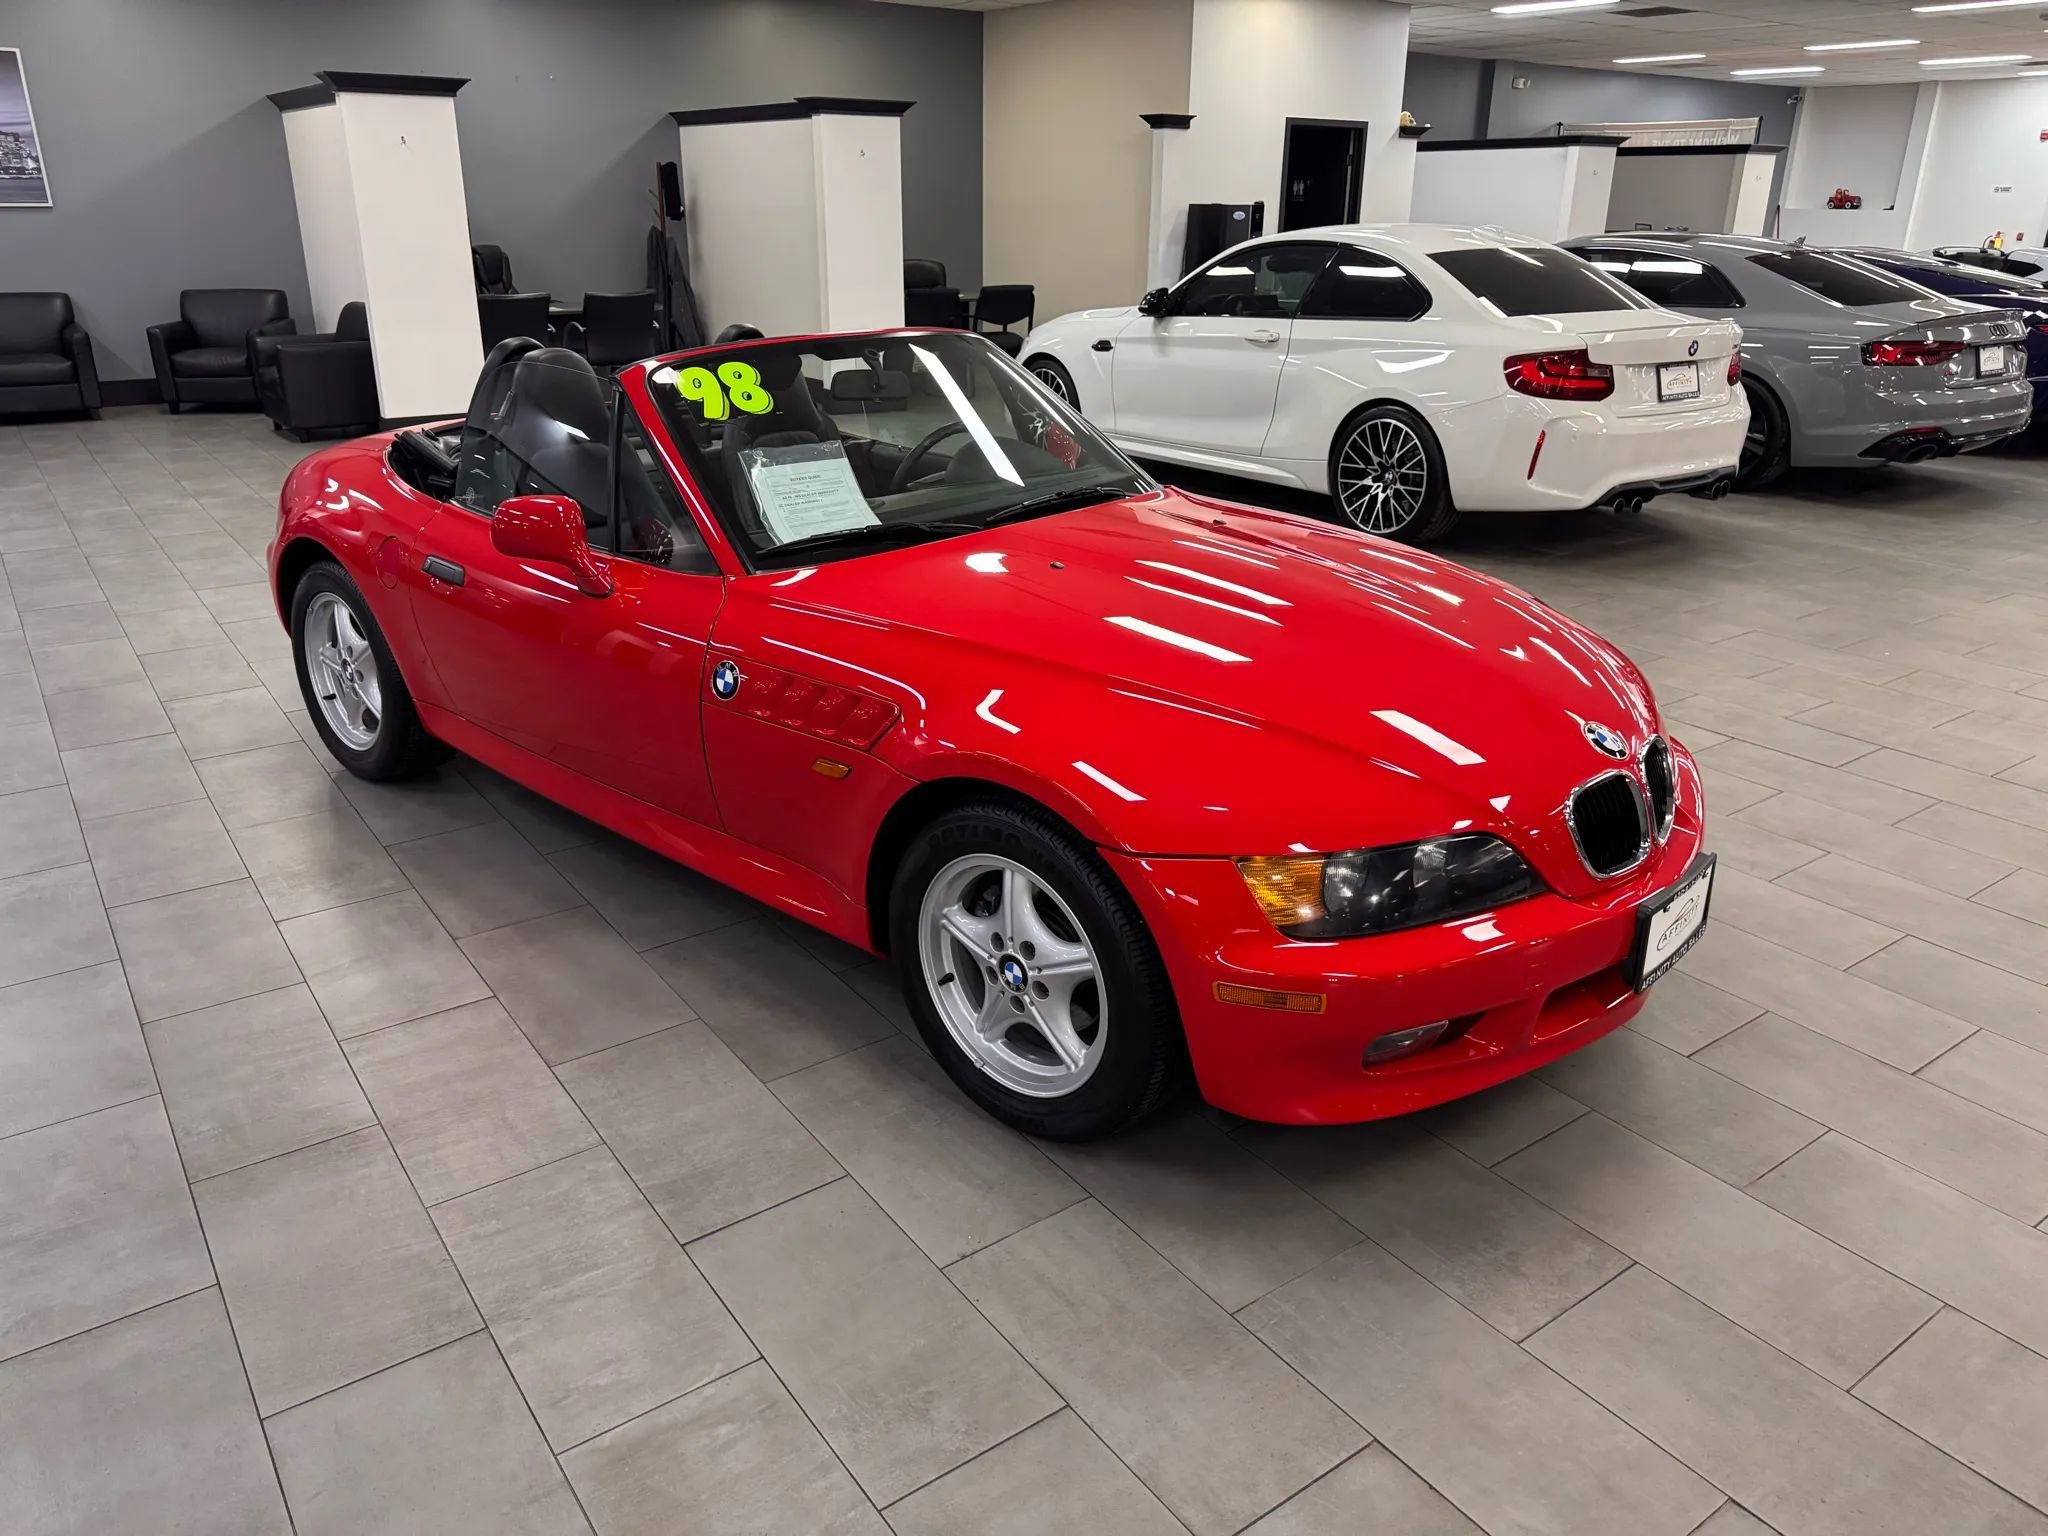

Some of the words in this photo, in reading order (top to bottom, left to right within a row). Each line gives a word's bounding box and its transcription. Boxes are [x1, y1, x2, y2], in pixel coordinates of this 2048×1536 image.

[677, 361, 774, 420] 98
[1641, 962, 1671, 992] AFFINITY
[1671, 945, 1687, 965] AUTO
[1688, 924, 1706, 951] SALES
